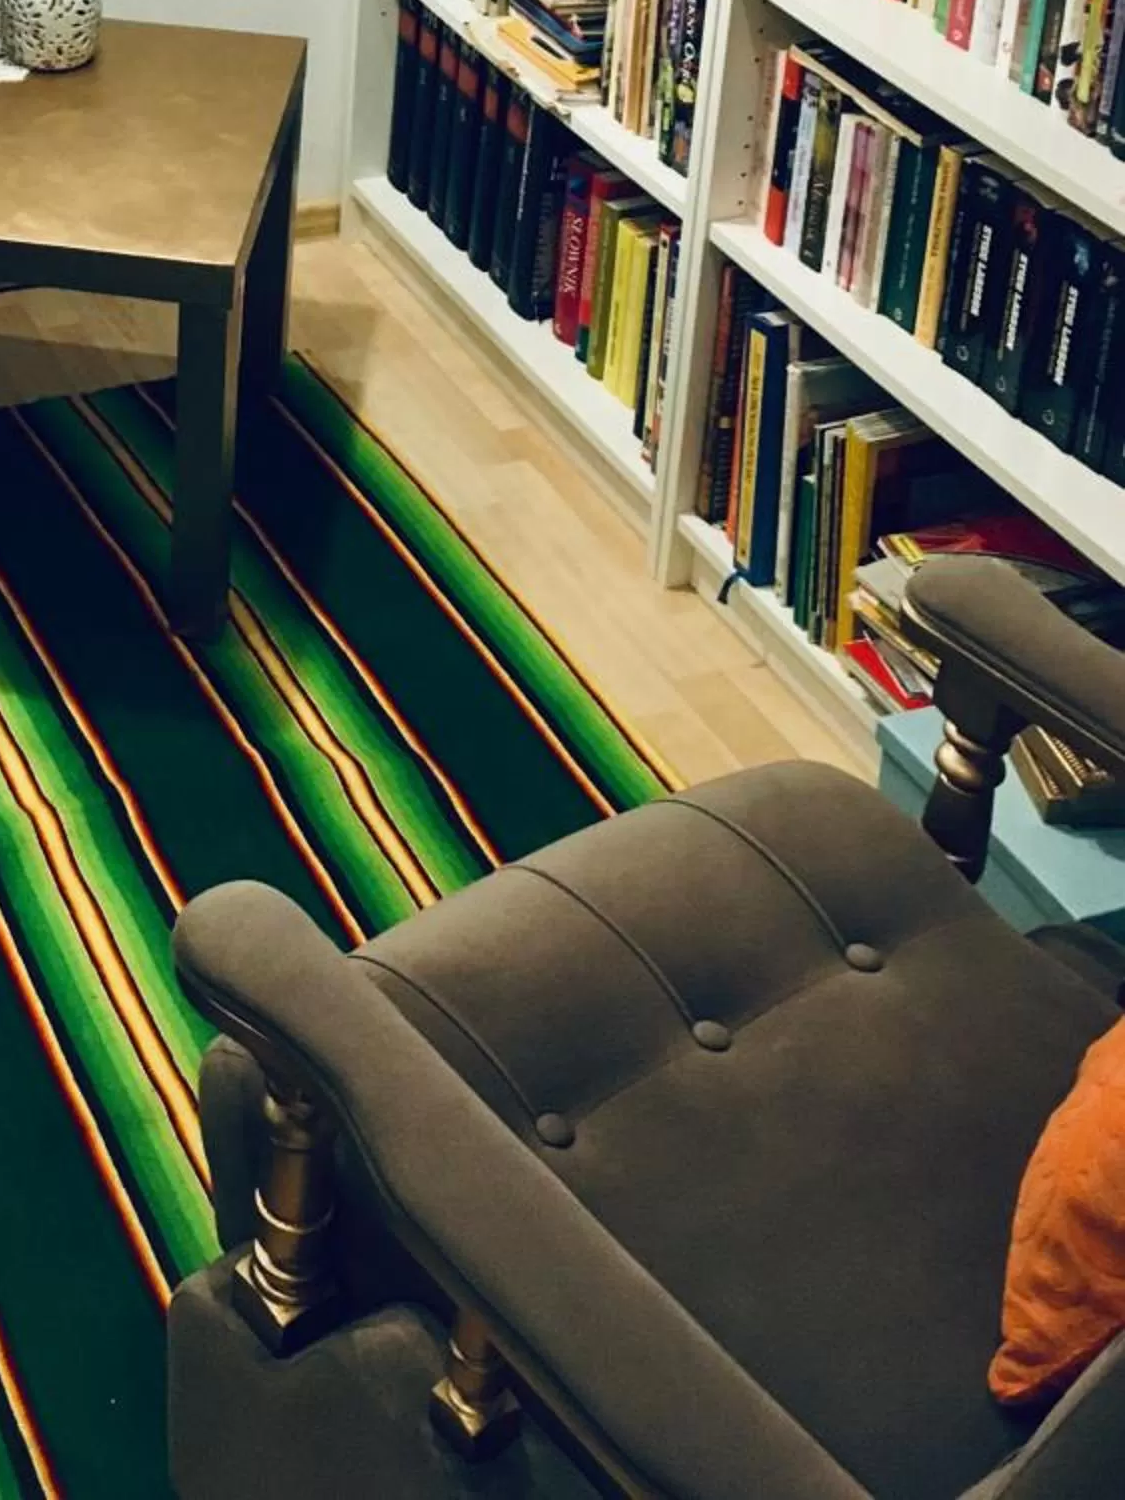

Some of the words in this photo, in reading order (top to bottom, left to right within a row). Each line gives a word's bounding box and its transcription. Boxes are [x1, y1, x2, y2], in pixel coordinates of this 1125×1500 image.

[970, 261, 986, 317] LARSSON
[1005, 292, 1022, 350] LARSSON
[1054, 325, 1072, 385] LARSSON
